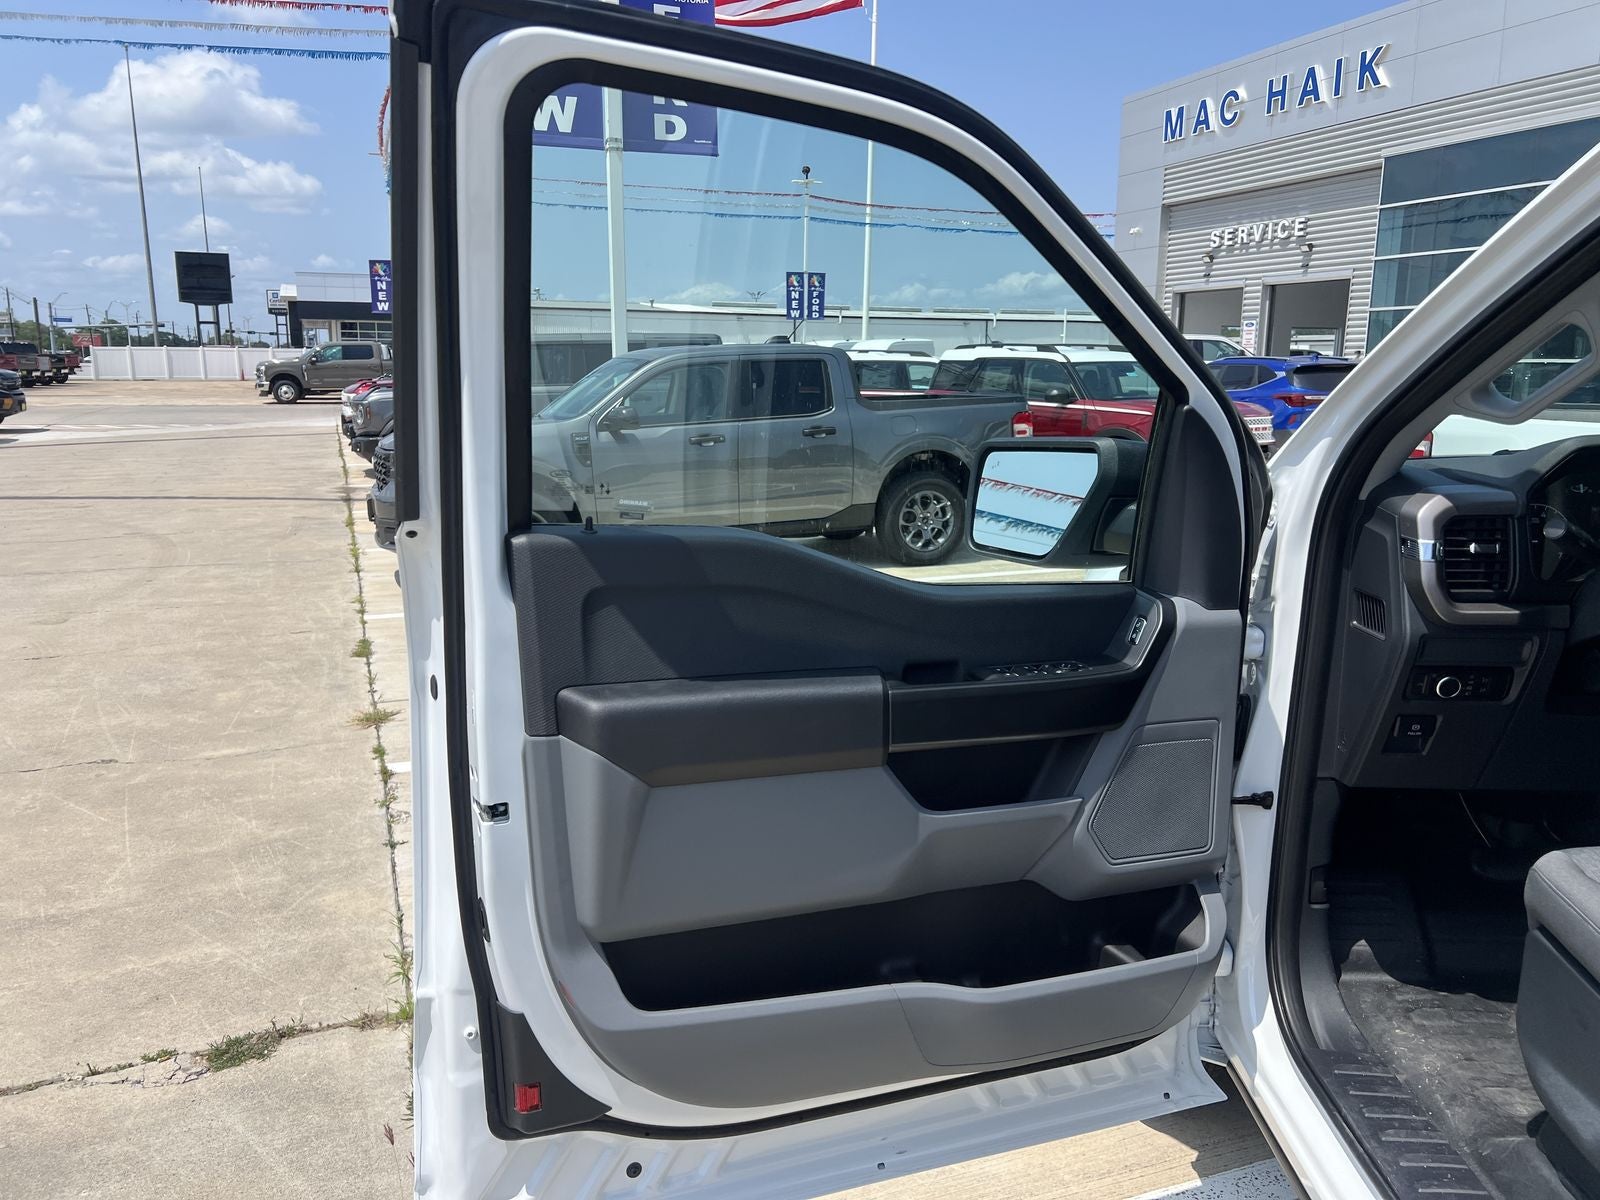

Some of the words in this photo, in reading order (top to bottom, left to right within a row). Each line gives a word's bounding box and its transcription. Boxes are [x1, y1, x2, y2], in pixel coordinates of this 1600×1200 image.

[1162, 88, 1242, 144] MAC
[1264, 43, 1389, 117] HAIK
[1209, 217, 1309, 249] SERVICE
[376, 281, 390, 311] NEW
[789, 291, 801, 318] NEW
[811, 291, 821, 318] FORD
